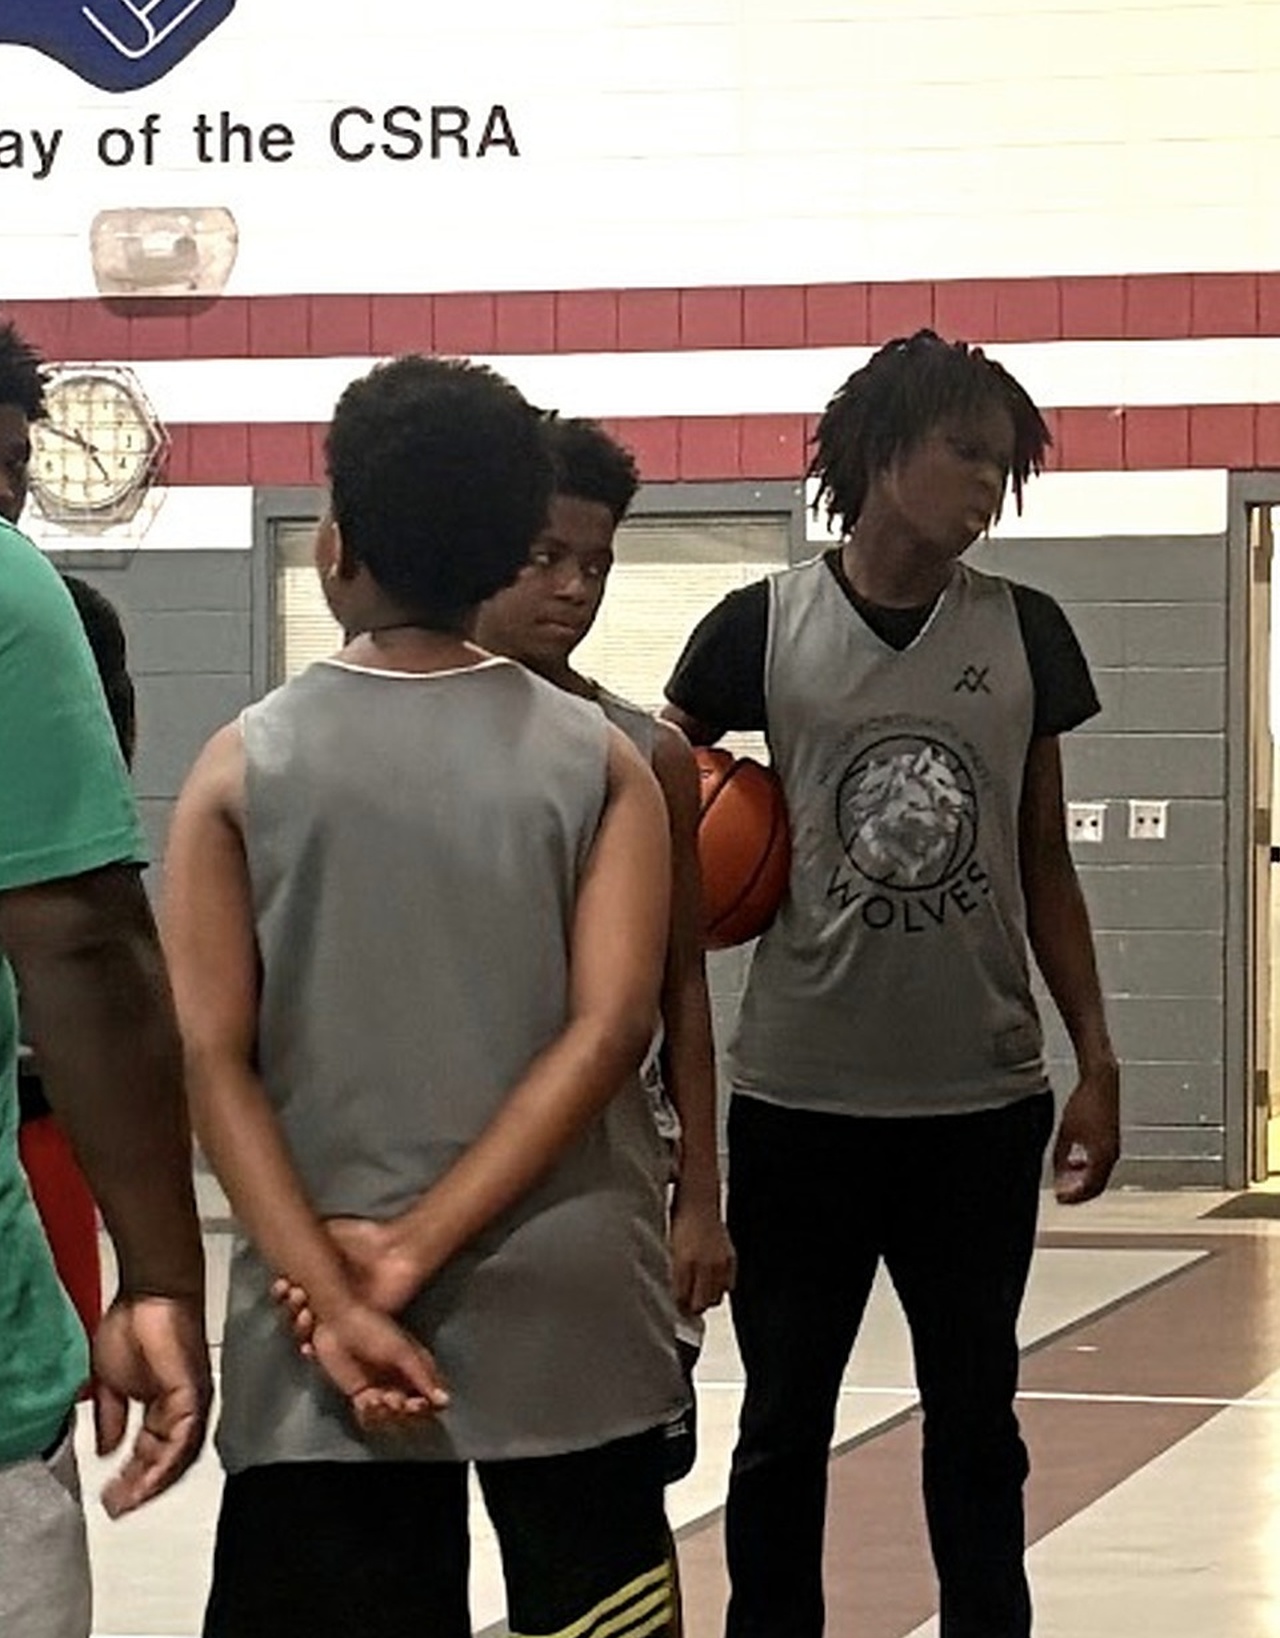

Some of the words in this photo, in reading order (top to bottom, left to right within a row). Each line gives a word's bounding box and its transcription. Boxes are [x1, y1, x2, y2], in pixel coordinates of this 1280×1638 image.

[97, 114, 161, 167] of
[192, 111, 295, 163] the
[330, 105, 520, 163] CSRA
[825, 860, 990, 933] WOLVES
